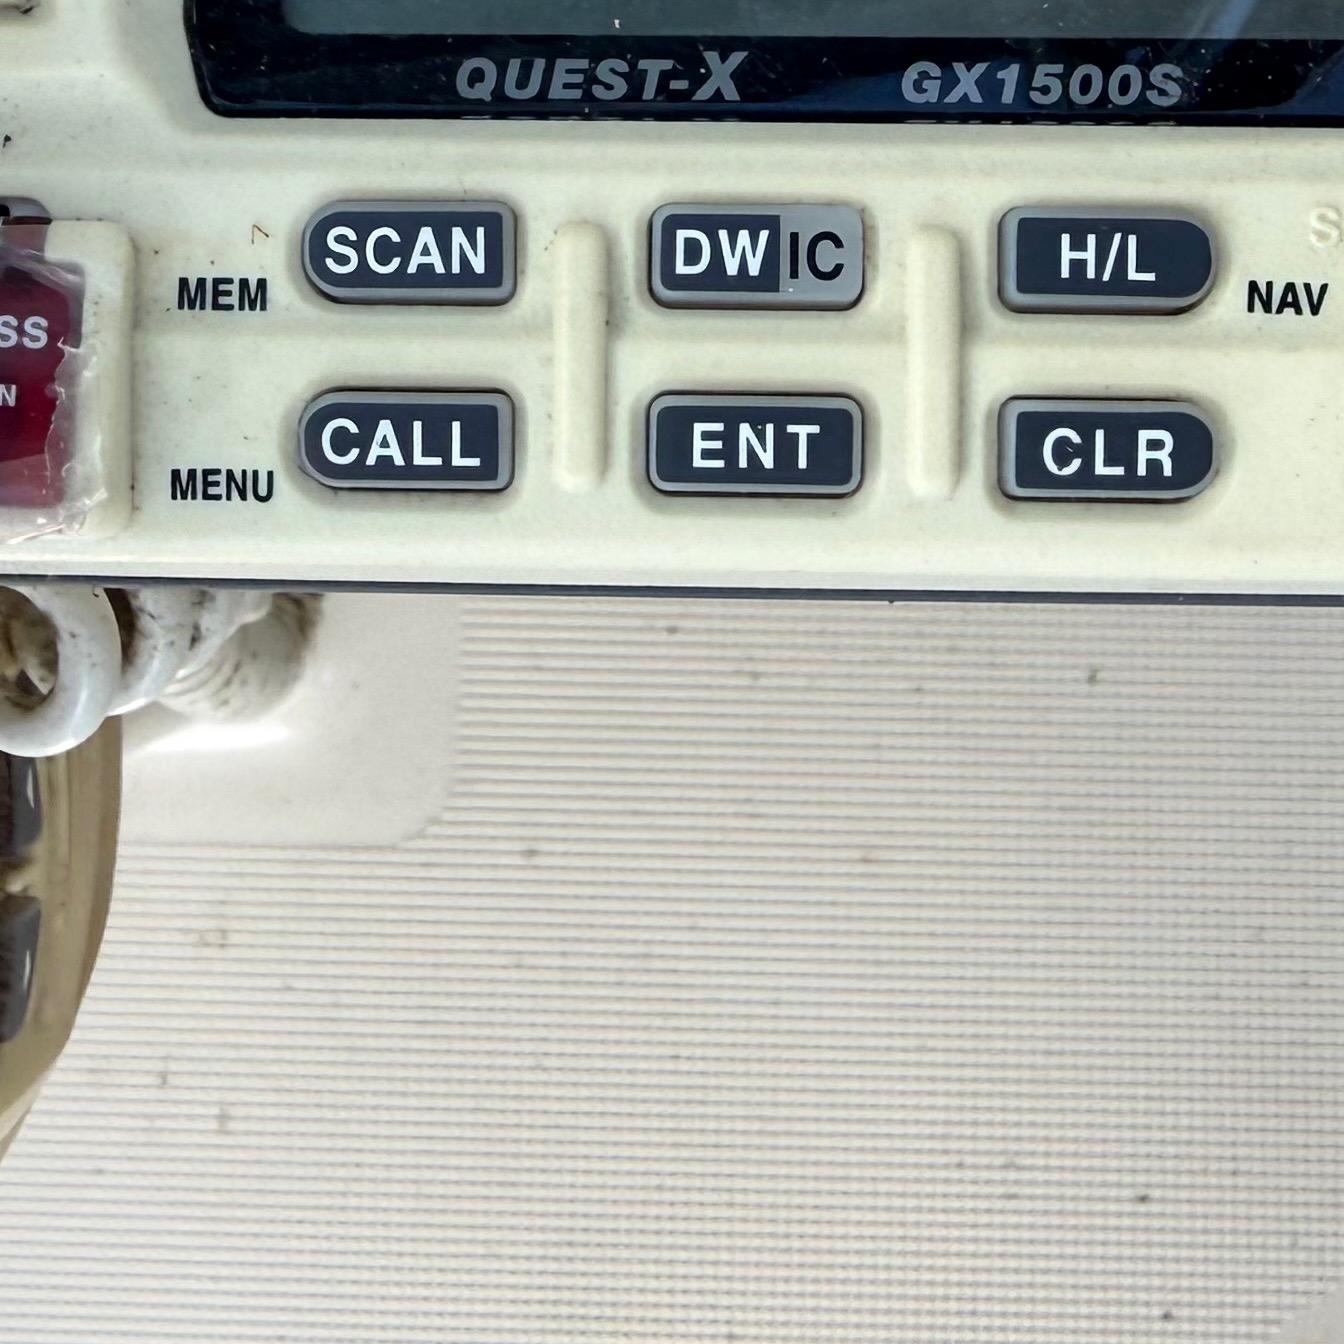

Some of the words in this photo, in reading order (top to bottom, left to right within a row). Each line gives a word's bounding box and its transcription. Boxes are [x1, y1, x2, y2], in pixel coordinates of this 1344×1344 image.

[456, 52, 743, 104] QUEST-X
[900, 62, 1186, 108] GX1500S
[324, 225, 487, 275] SCAN
[1059, 232, 1157, 283] H/L
[176, 276, 269, 312] MEM
[1247, 280, 1329, 317] NAV
[321, 417, 481, 468] CALL
[691, 422, 821, 471] ENT
[1042, 428, 1174, 478] CLR
[170, 468, 275, 503] MENU
